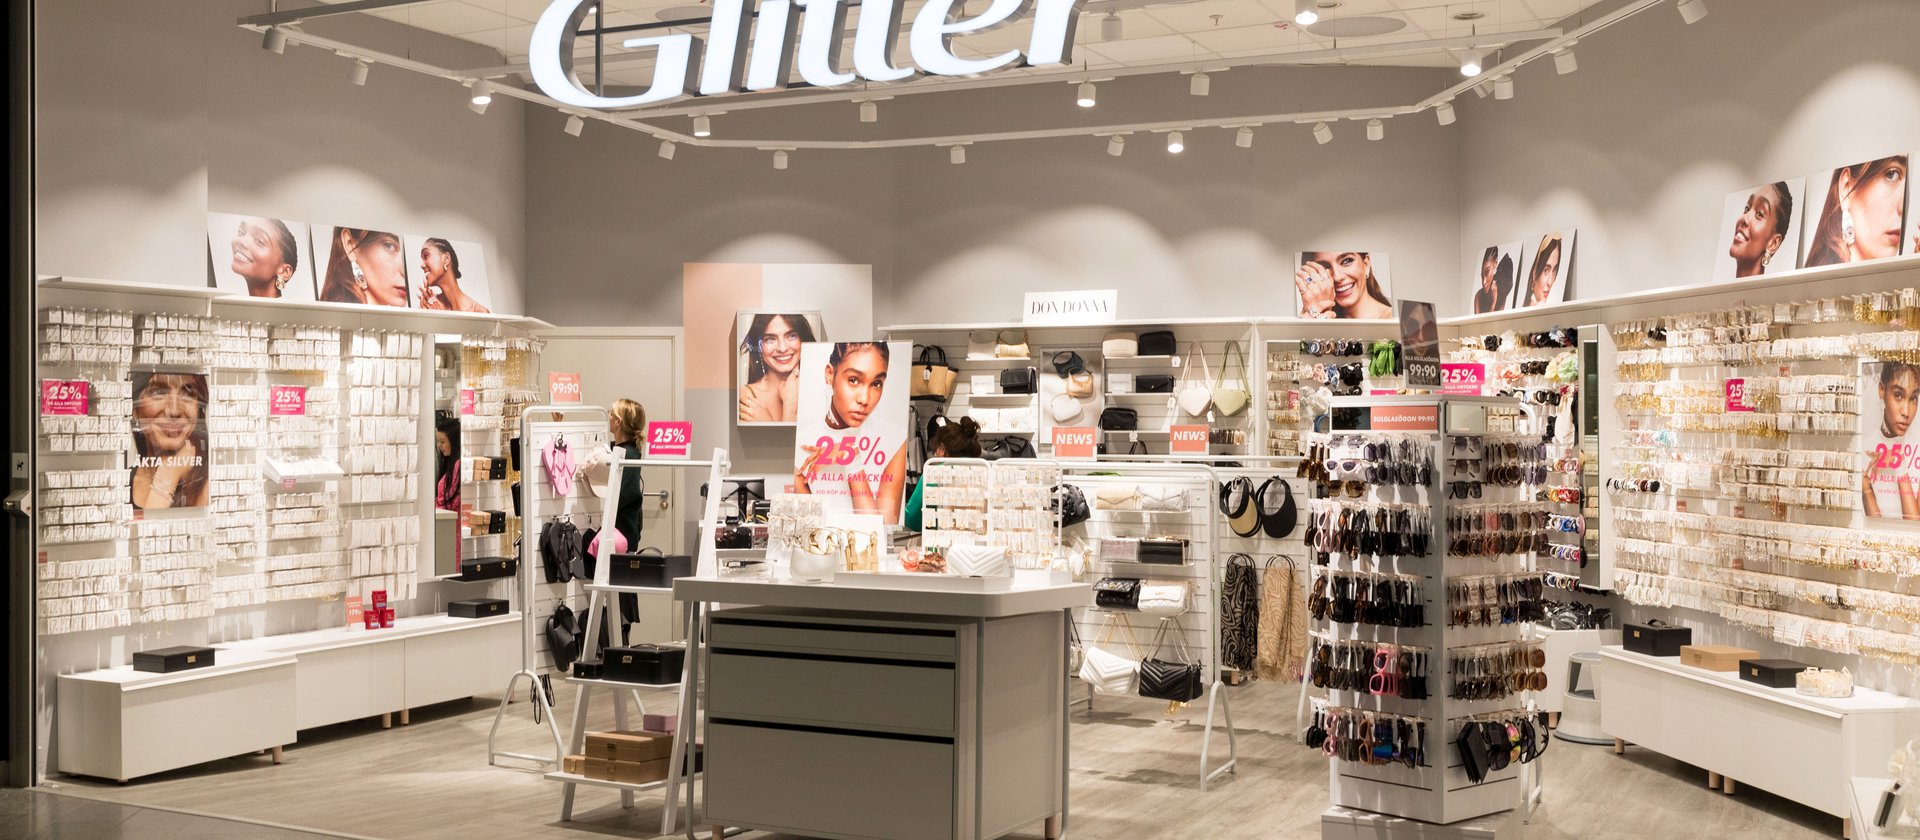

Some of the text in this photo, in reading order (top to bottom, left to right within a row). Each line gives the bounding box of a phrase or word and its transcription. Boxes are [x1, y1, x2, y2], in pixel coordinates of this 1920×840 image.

[529, 0, 1086, 108] Glitter
[1031, 299, 1107, 314] DON DONNA
[1409, 363, 1436, 377] 99:90
[1441, 368, 1477, 384] 25%
[48, 385, 82, 400] 25%
[552, 382, 579, 394] 99:90
[275, 390, 301, 403] 25%
[1373, 414, 1417, 423] SOLGLASÖGON
[653, 427, 685, 443] 25%
[1055, 433, 1093, 445] NEWS
[1173, 430, 1206, 441] NEWS
[814, 435, 886, 466] 25%
[1875, 443, 1920, 470] 25%
[133, 453, 203, 468] ÄKTA SILVER
[820, 472, 845, 482] ALLA
[847, 473, 894, 483] SMYCKEN
